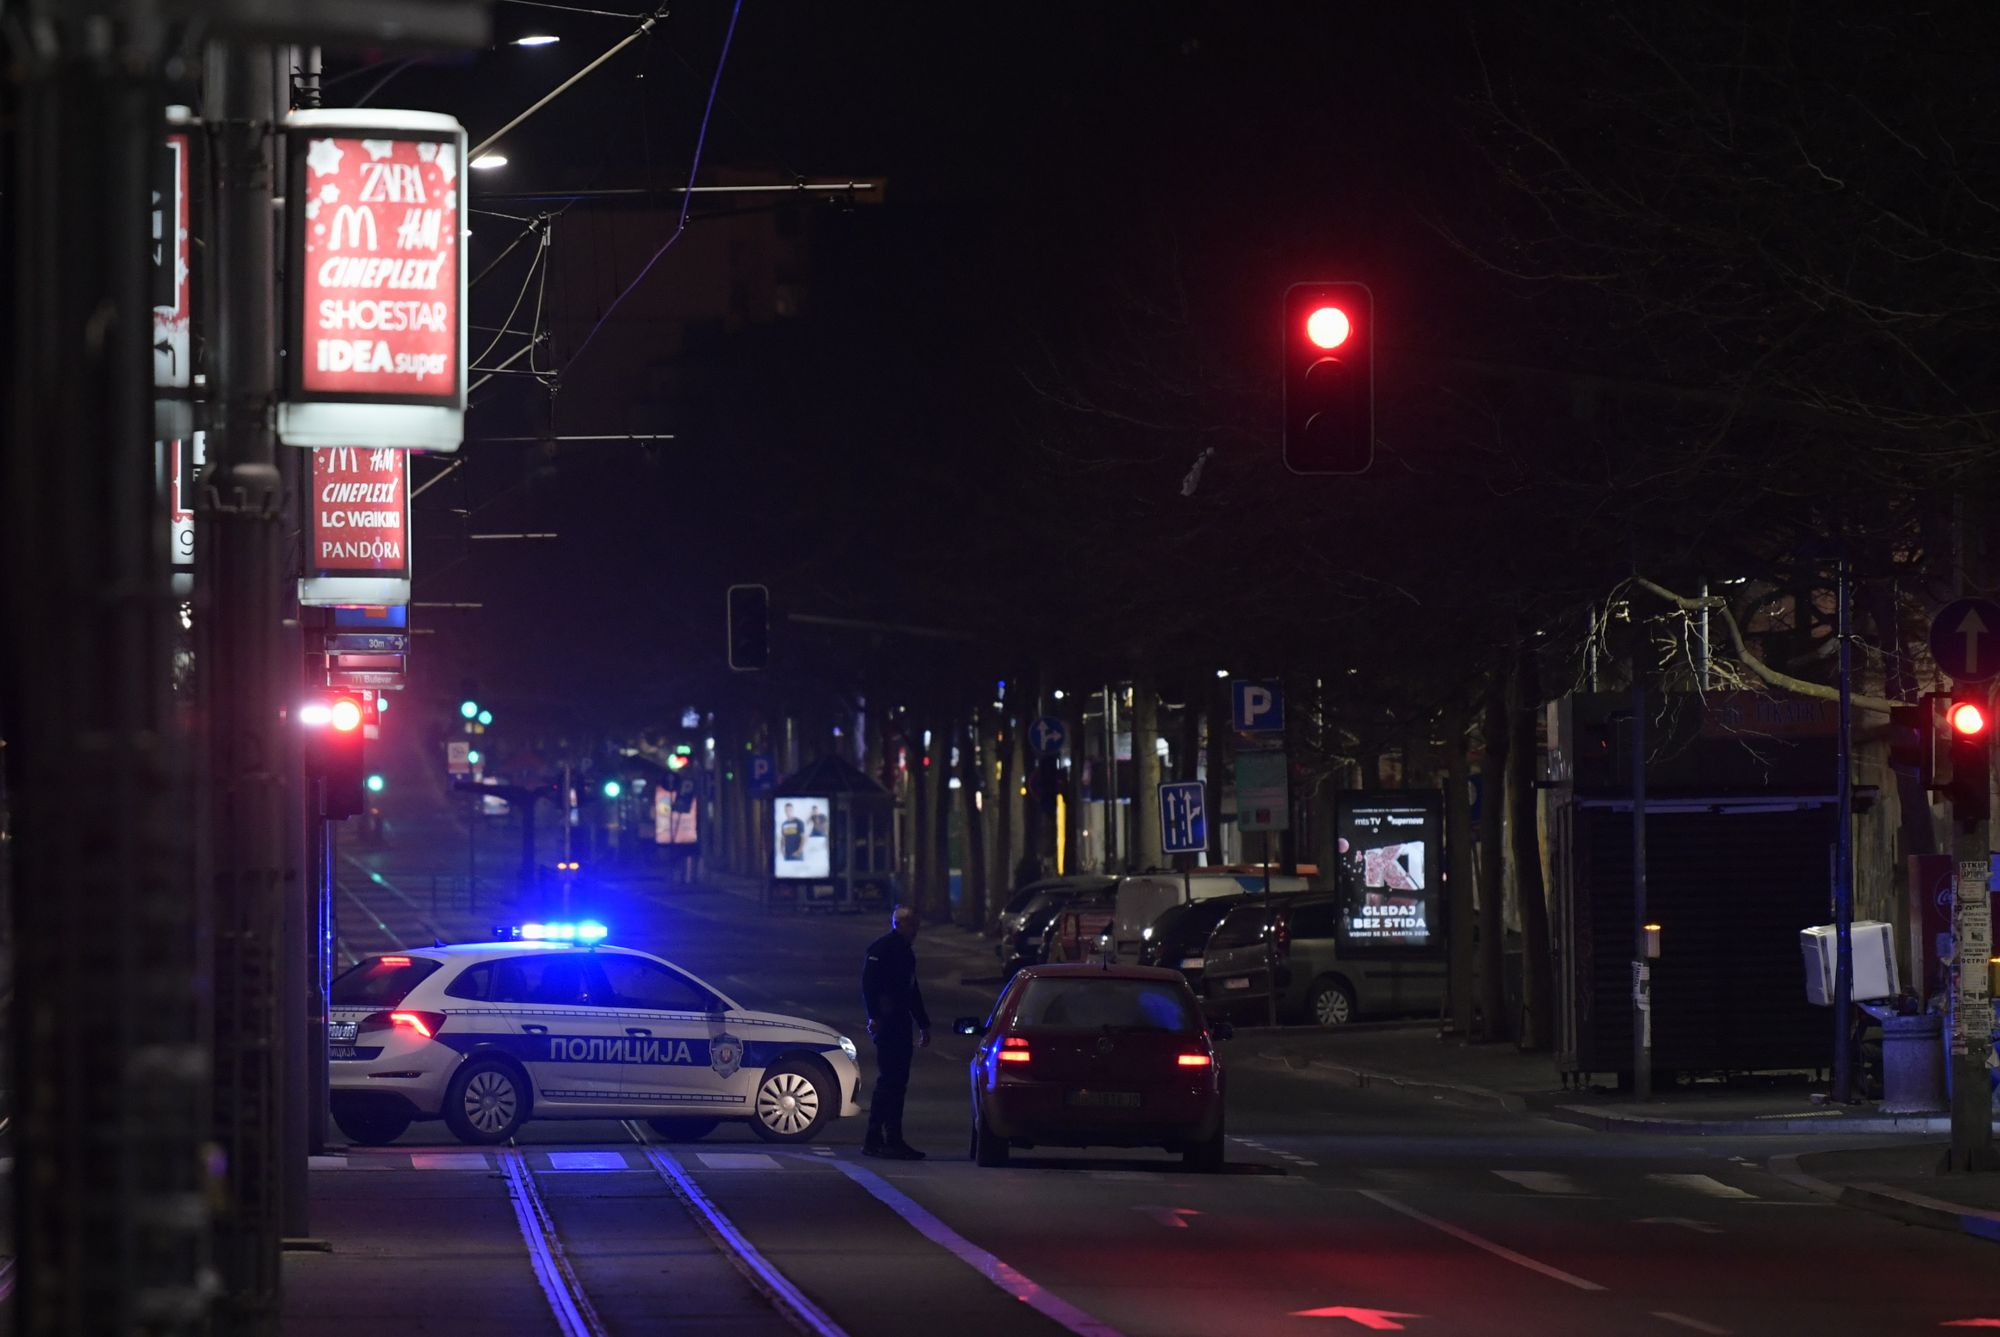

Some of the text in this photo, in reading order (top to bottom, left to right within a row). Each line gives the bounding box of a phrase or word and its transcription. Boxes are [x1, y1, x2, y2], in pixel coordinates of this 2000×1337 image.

[360, 162, 427, 203] ZARA
[397, 208, 442, 252] H&M
[317, 251, 447, 291] CINEPLEXX
[319, 299, 448, 333] SHOESTAR
[317, 339, 448, 381] IDEA super
[321, 477, 399, 504] CINEPLEXX
[321, 510, 345, 528] LC
[322, 536, 401, 562] PANDORA
[1243, 686, 1272, 726] P
[1370, 817, 1382, 826] TV
[1353, 917, 1427, 929] BEZ STIDA
[1362, 905, 1417, 917] GLEDAJ
[550, 1036, 692, 1065] ПОЛИЦИЈА
